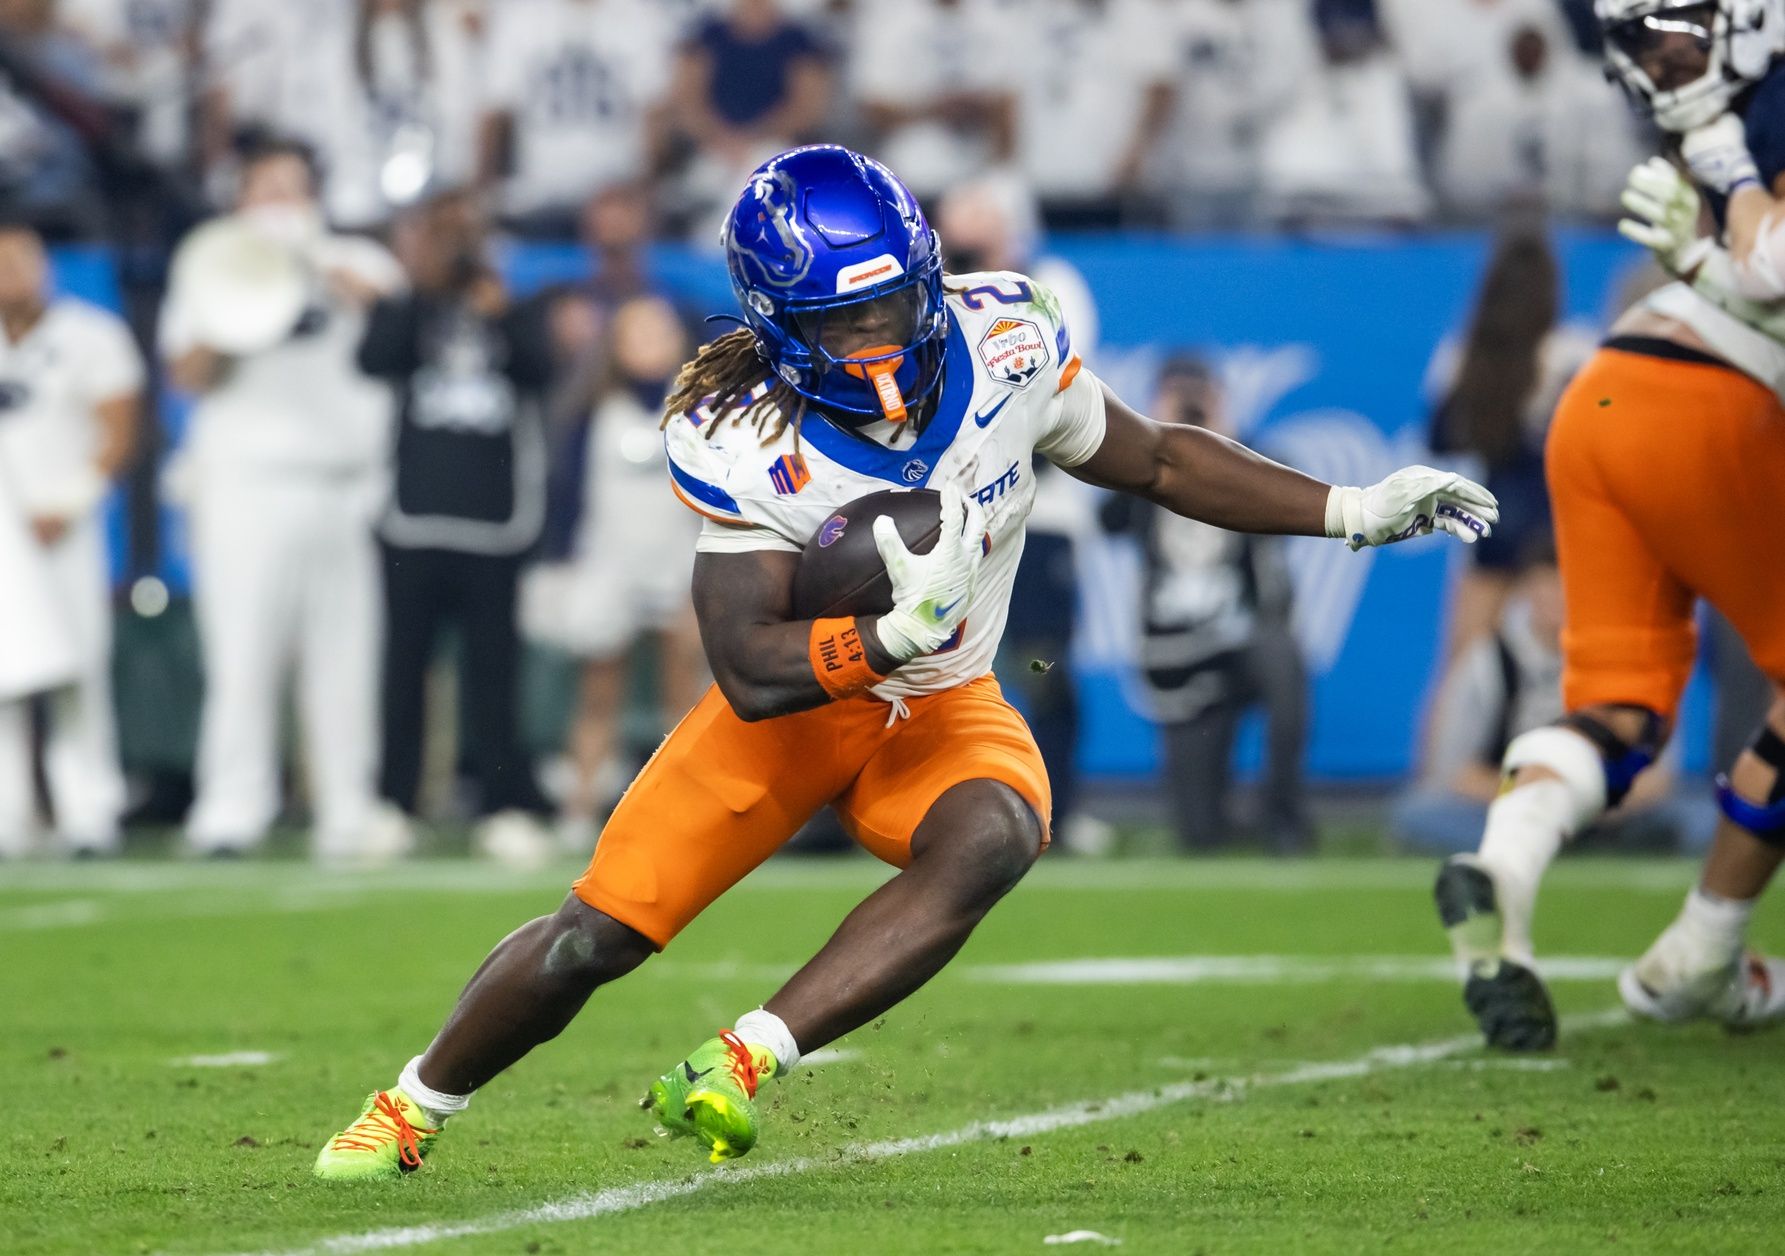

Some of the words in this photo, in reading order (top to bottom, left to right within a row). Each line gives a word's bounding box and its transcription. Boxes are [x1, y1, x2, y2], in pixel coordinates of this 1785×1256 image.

[961, 281, 1033, 311] 2
[987, 349, 1016, 368] Fiesta
[1015, 341, 1043, 353] Bowl
[819, 634, 843, 672] PHIL
[841, 628, 863, 661] 4:13
